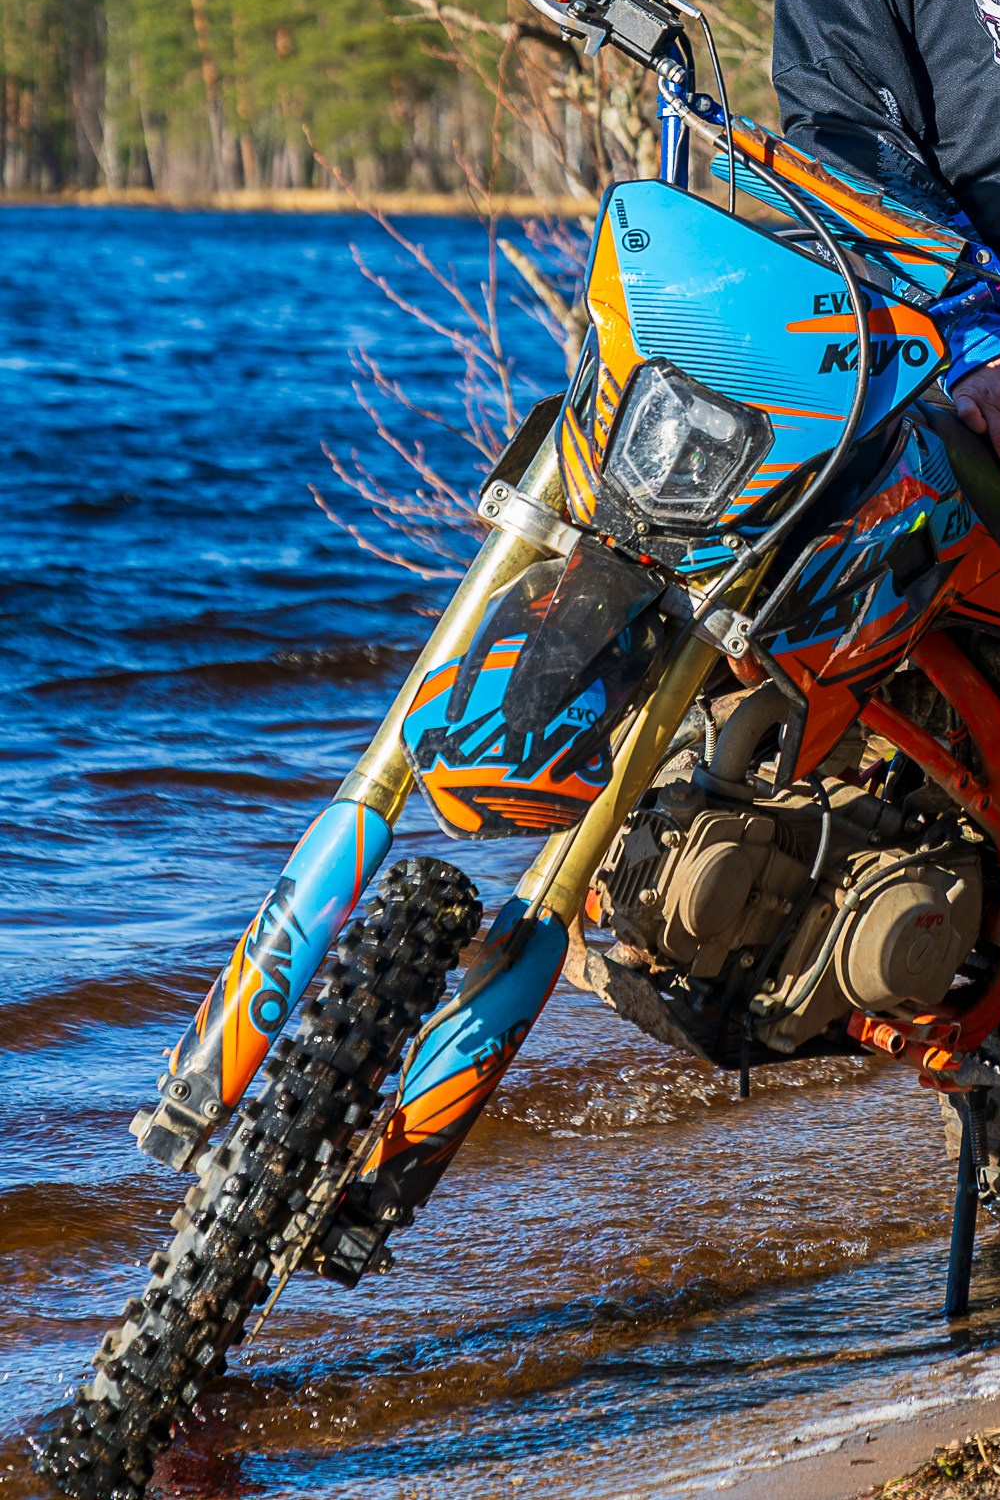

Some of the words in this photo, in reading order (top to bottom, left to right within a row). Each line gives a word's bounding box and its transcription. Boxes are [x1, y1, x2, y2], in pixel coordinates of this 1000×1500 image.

[813, 290, 873, 316] EVO
[566, 706, 598, 725] EVO
[471, 1017, 534, 1081] EVO
